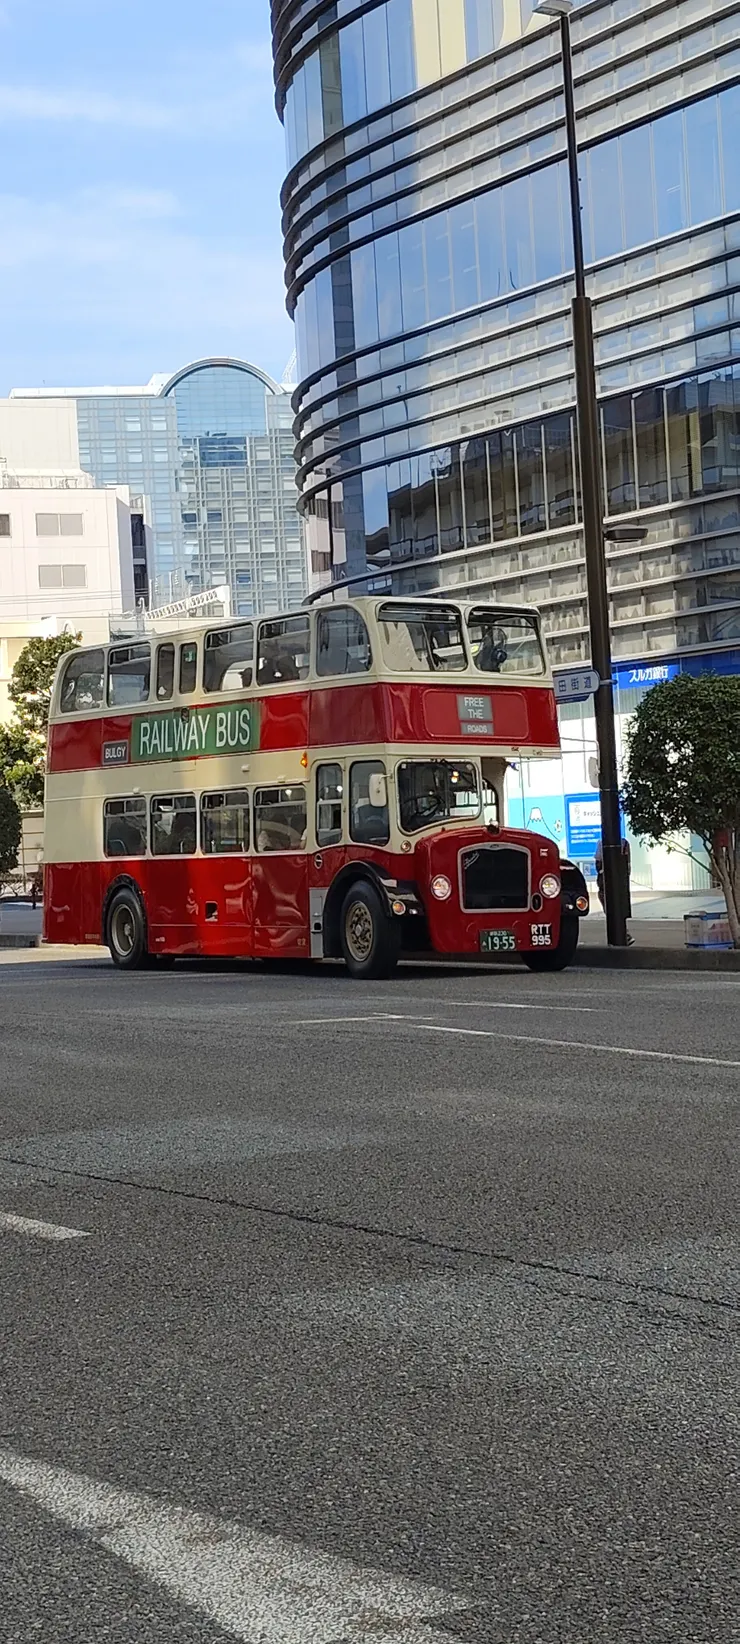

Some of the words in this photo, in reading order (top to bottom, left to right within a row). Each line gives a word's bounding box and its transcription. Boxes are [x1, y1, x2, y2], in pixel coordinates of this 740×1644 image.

[628, 666, 669, 683] スルガ銀行
[464, 696, 484, 708] FREE
[468, 709, 484, 719] THE
[140, 714, 210, 755] RAILWAY
[215, 708, 251, 748] BUS
[467, 724, 488, 733] ROADS
[104, 746, 126, 759] BULGY
[531, 924, 551, 935] RTT
[532, 935, 552, 946] 995
